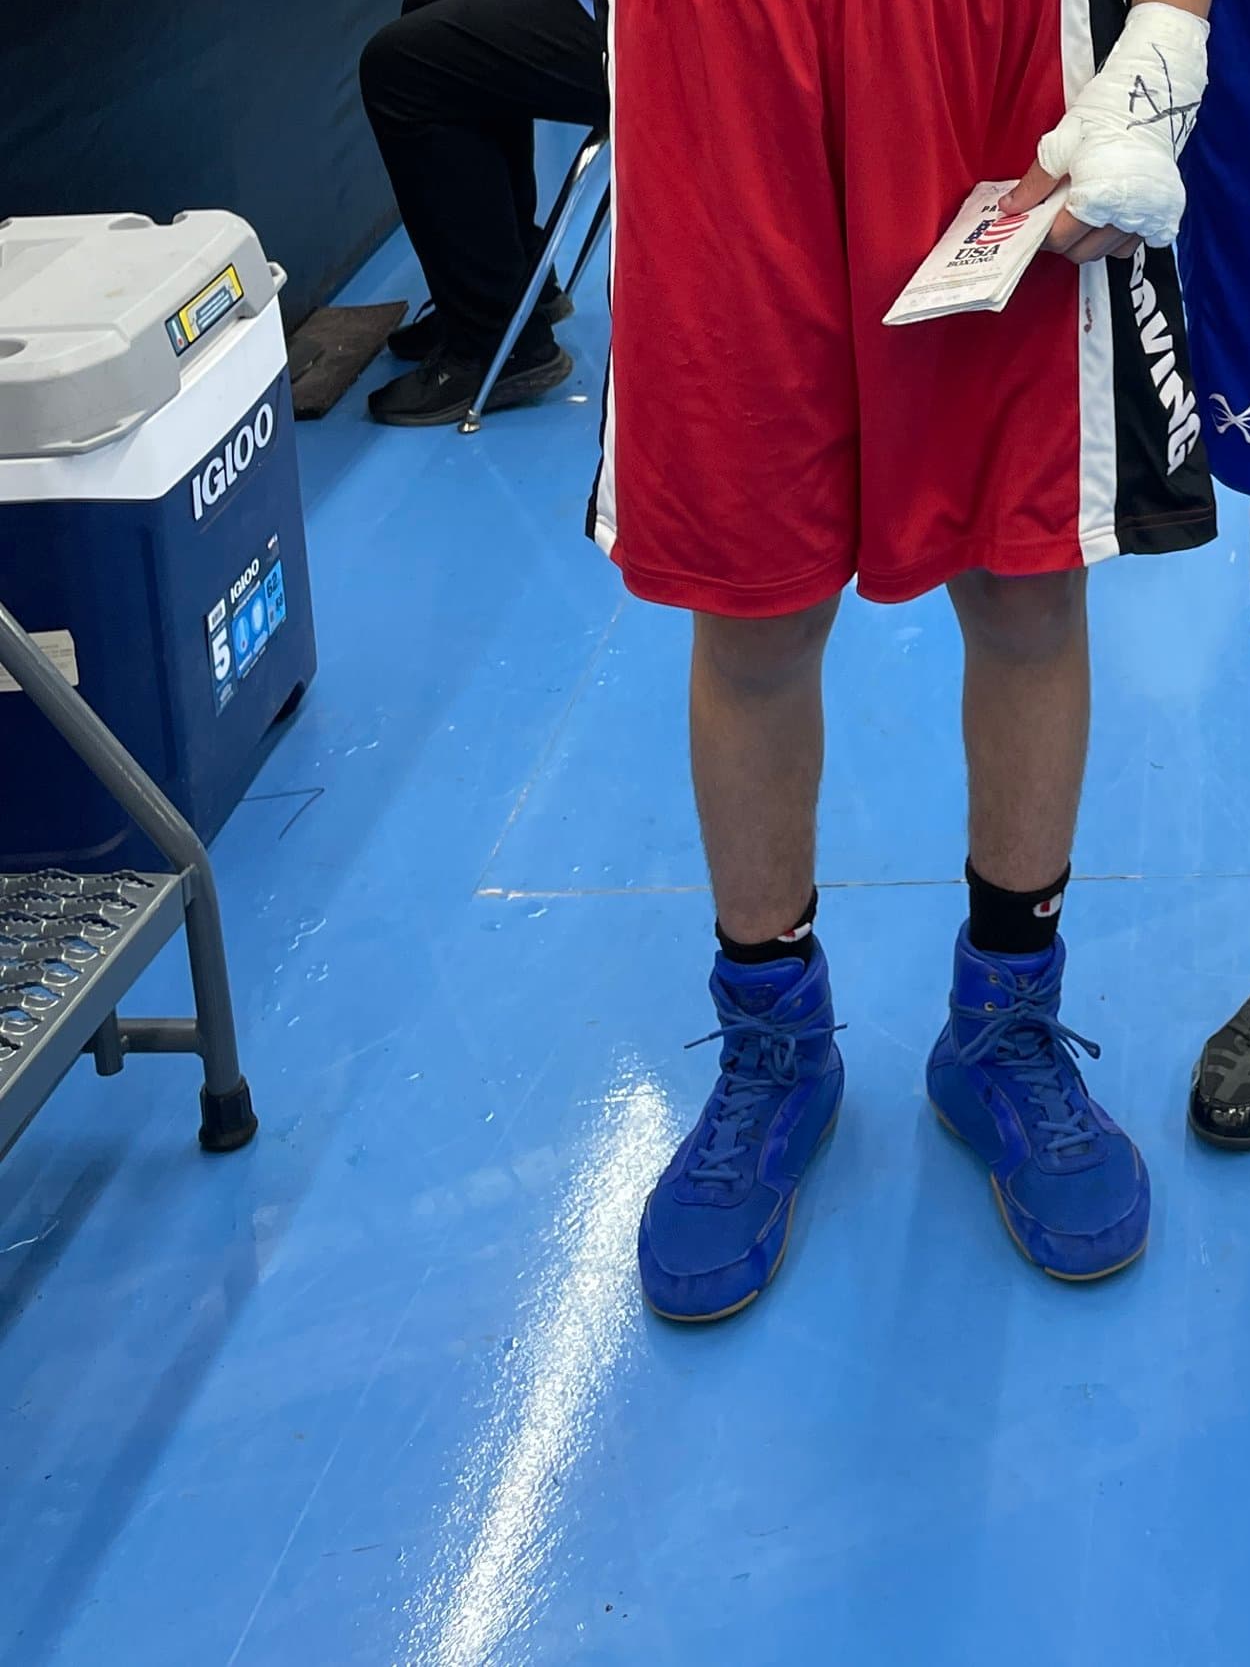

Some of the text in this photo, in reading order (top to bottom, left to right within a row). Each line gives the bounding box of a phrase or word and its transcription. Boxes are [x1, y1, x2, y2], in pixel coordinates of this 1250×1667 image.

[946, 255, 995, 268] BOXING
[954, 243, 1001, 261] USA
[192, 402, 274, 522] IGLOO
[229, 557, 261, 605] IGLOO
